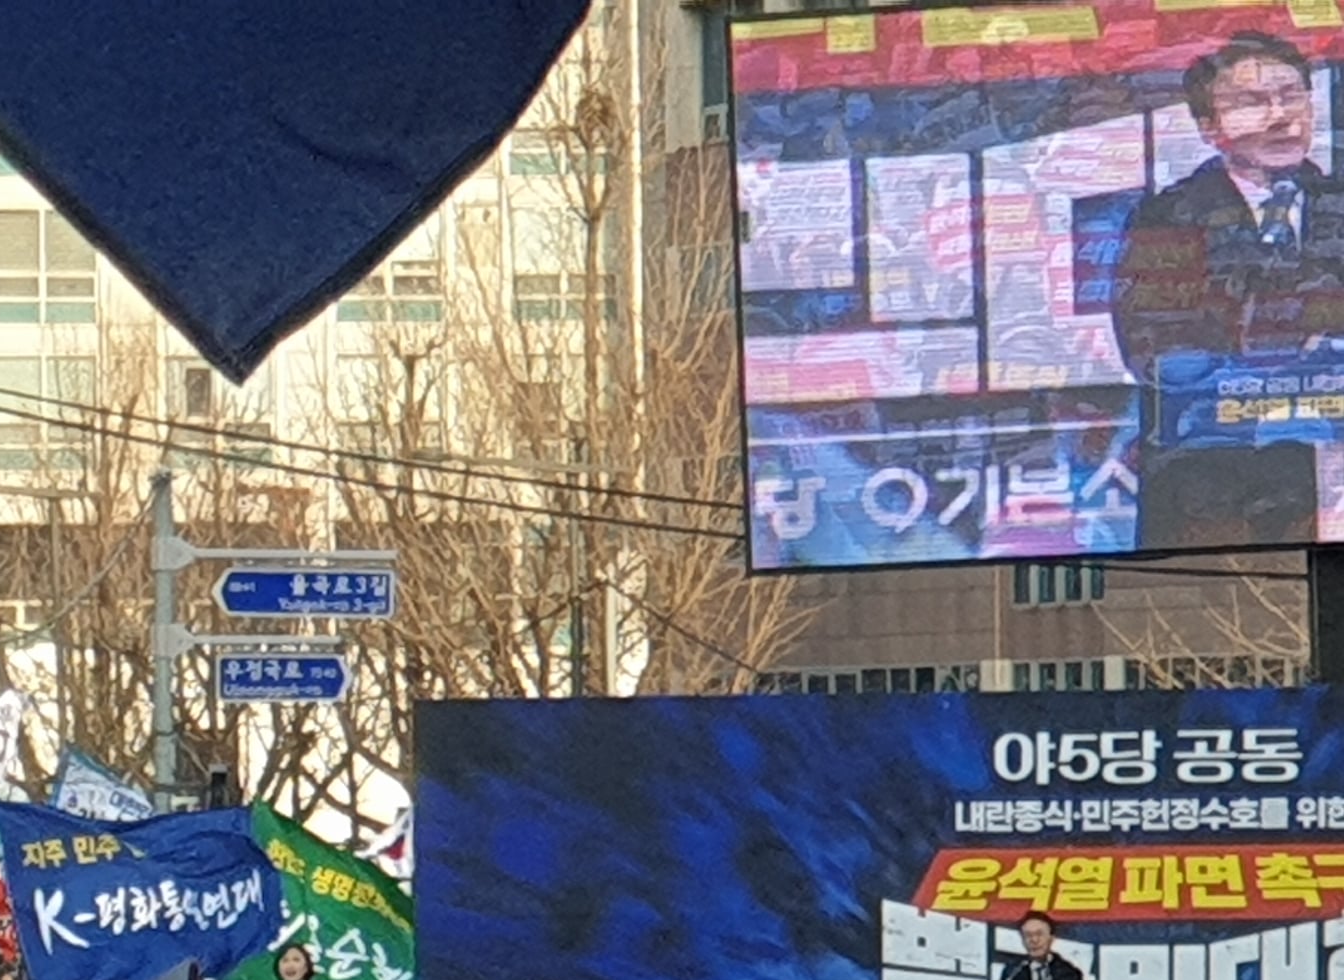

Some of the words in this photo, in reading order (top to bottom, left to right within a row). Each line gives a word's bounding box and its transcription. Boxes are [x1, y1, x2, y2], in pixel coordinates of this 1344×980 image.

[994, 729, 1160, 786] 야5당
[1174, 729, 1304, 784] 공동
[935, 857, 1115, 912] 윤석열
[1124, 854, 1246, 910] 파면
